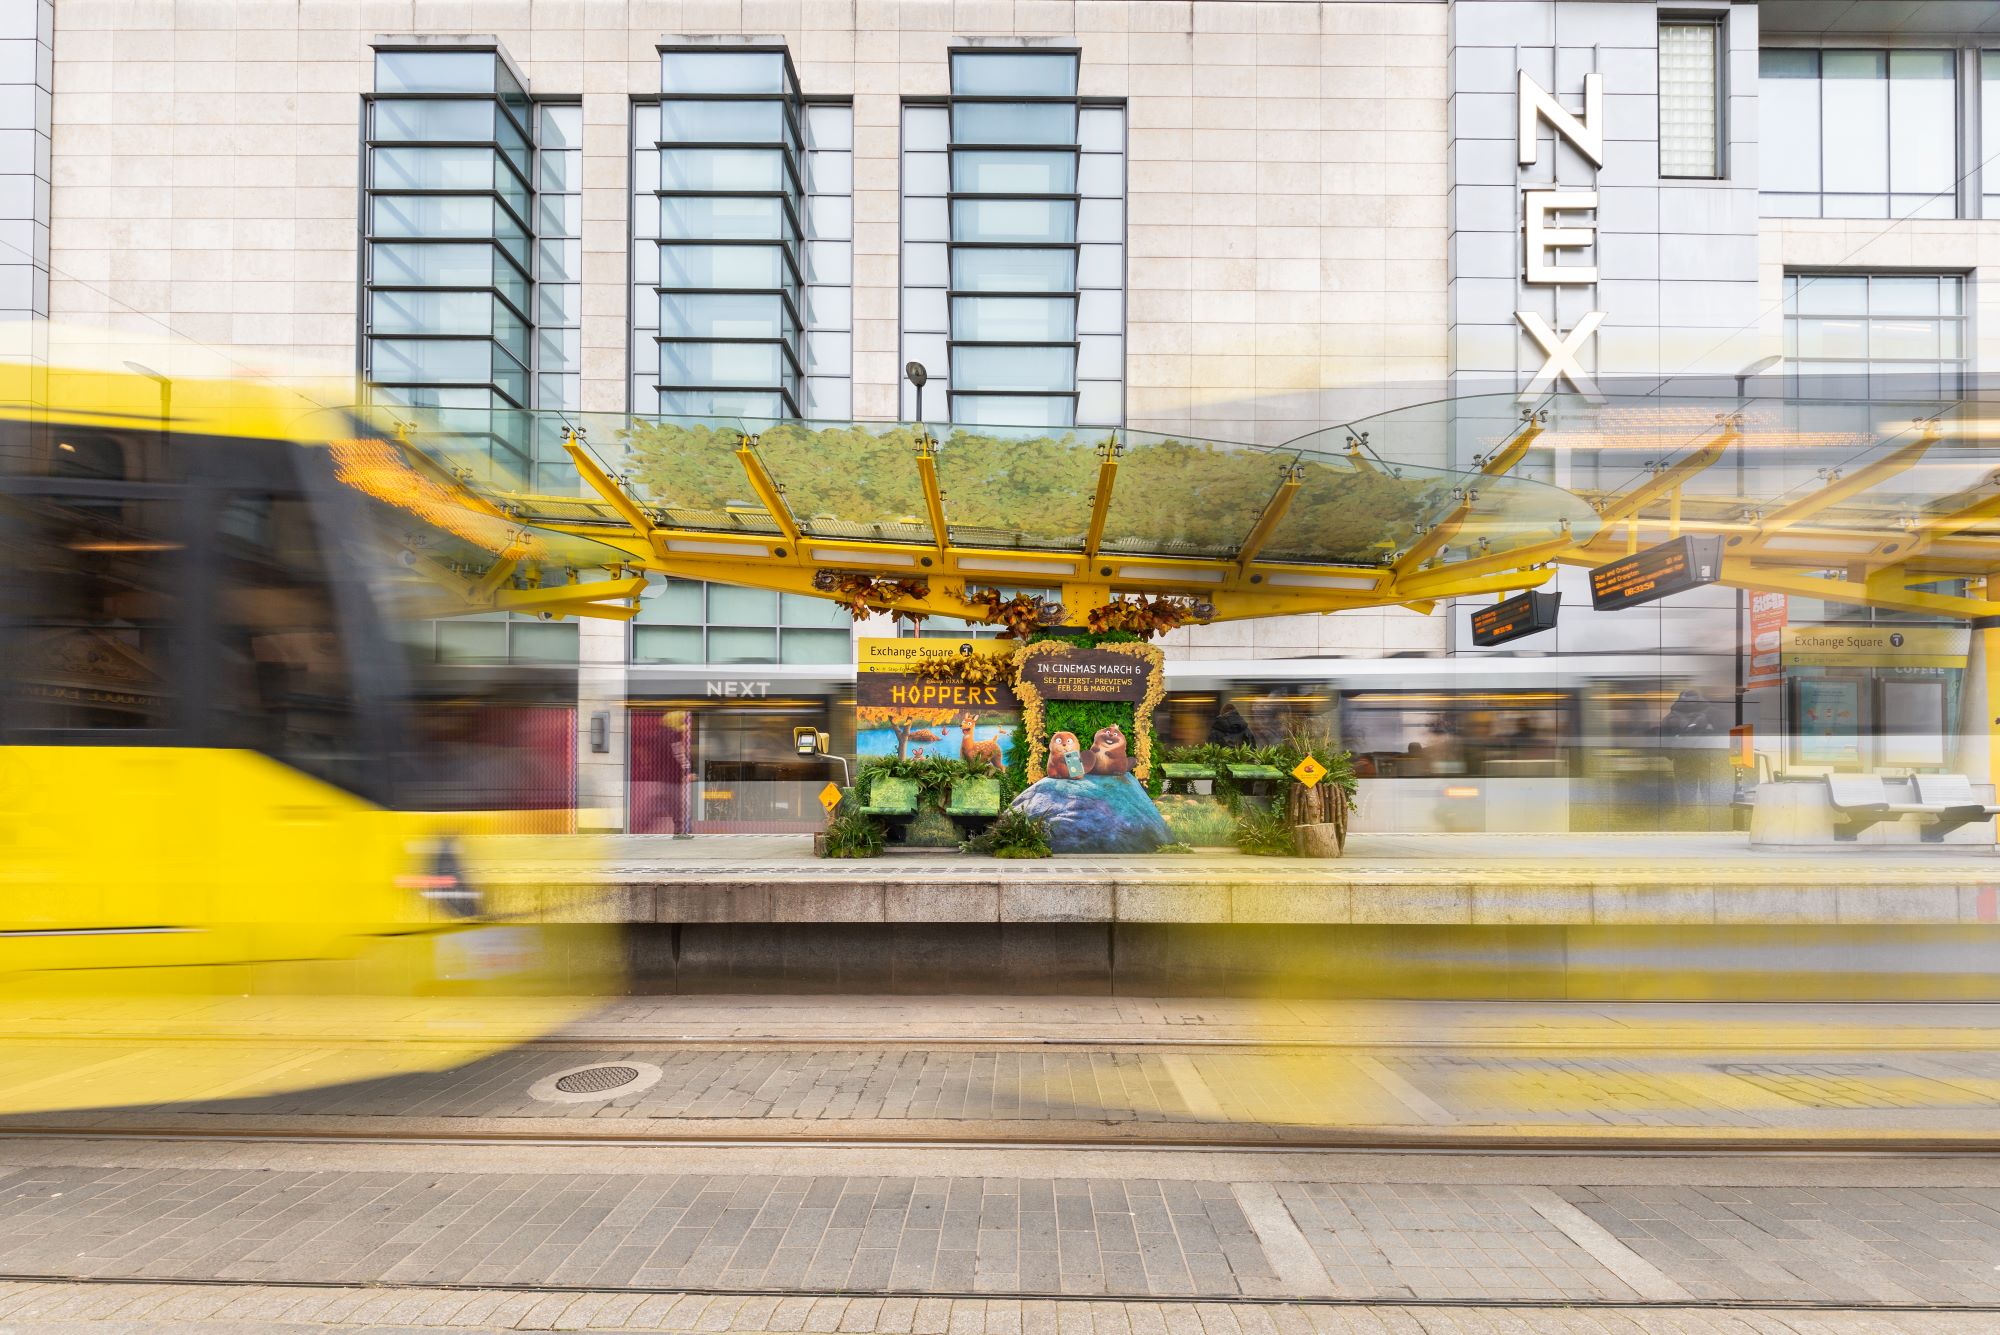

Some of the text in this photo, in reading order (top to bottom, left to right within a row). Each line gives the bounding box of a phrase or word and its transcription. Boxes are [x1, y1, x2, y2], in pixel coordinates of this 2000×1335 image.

[1795, 636, 1884, 649] Exchange Square
[870, 646, 954, 659] Exchange Square
[1038, 664, 1141, 674] IN CINEMAS MARCH 6
[1094, 678, 1133, 686] PREVIEWS
[706, 681, 770, 698] NEXT
[892, 686, 998, 704] HOPPERS
